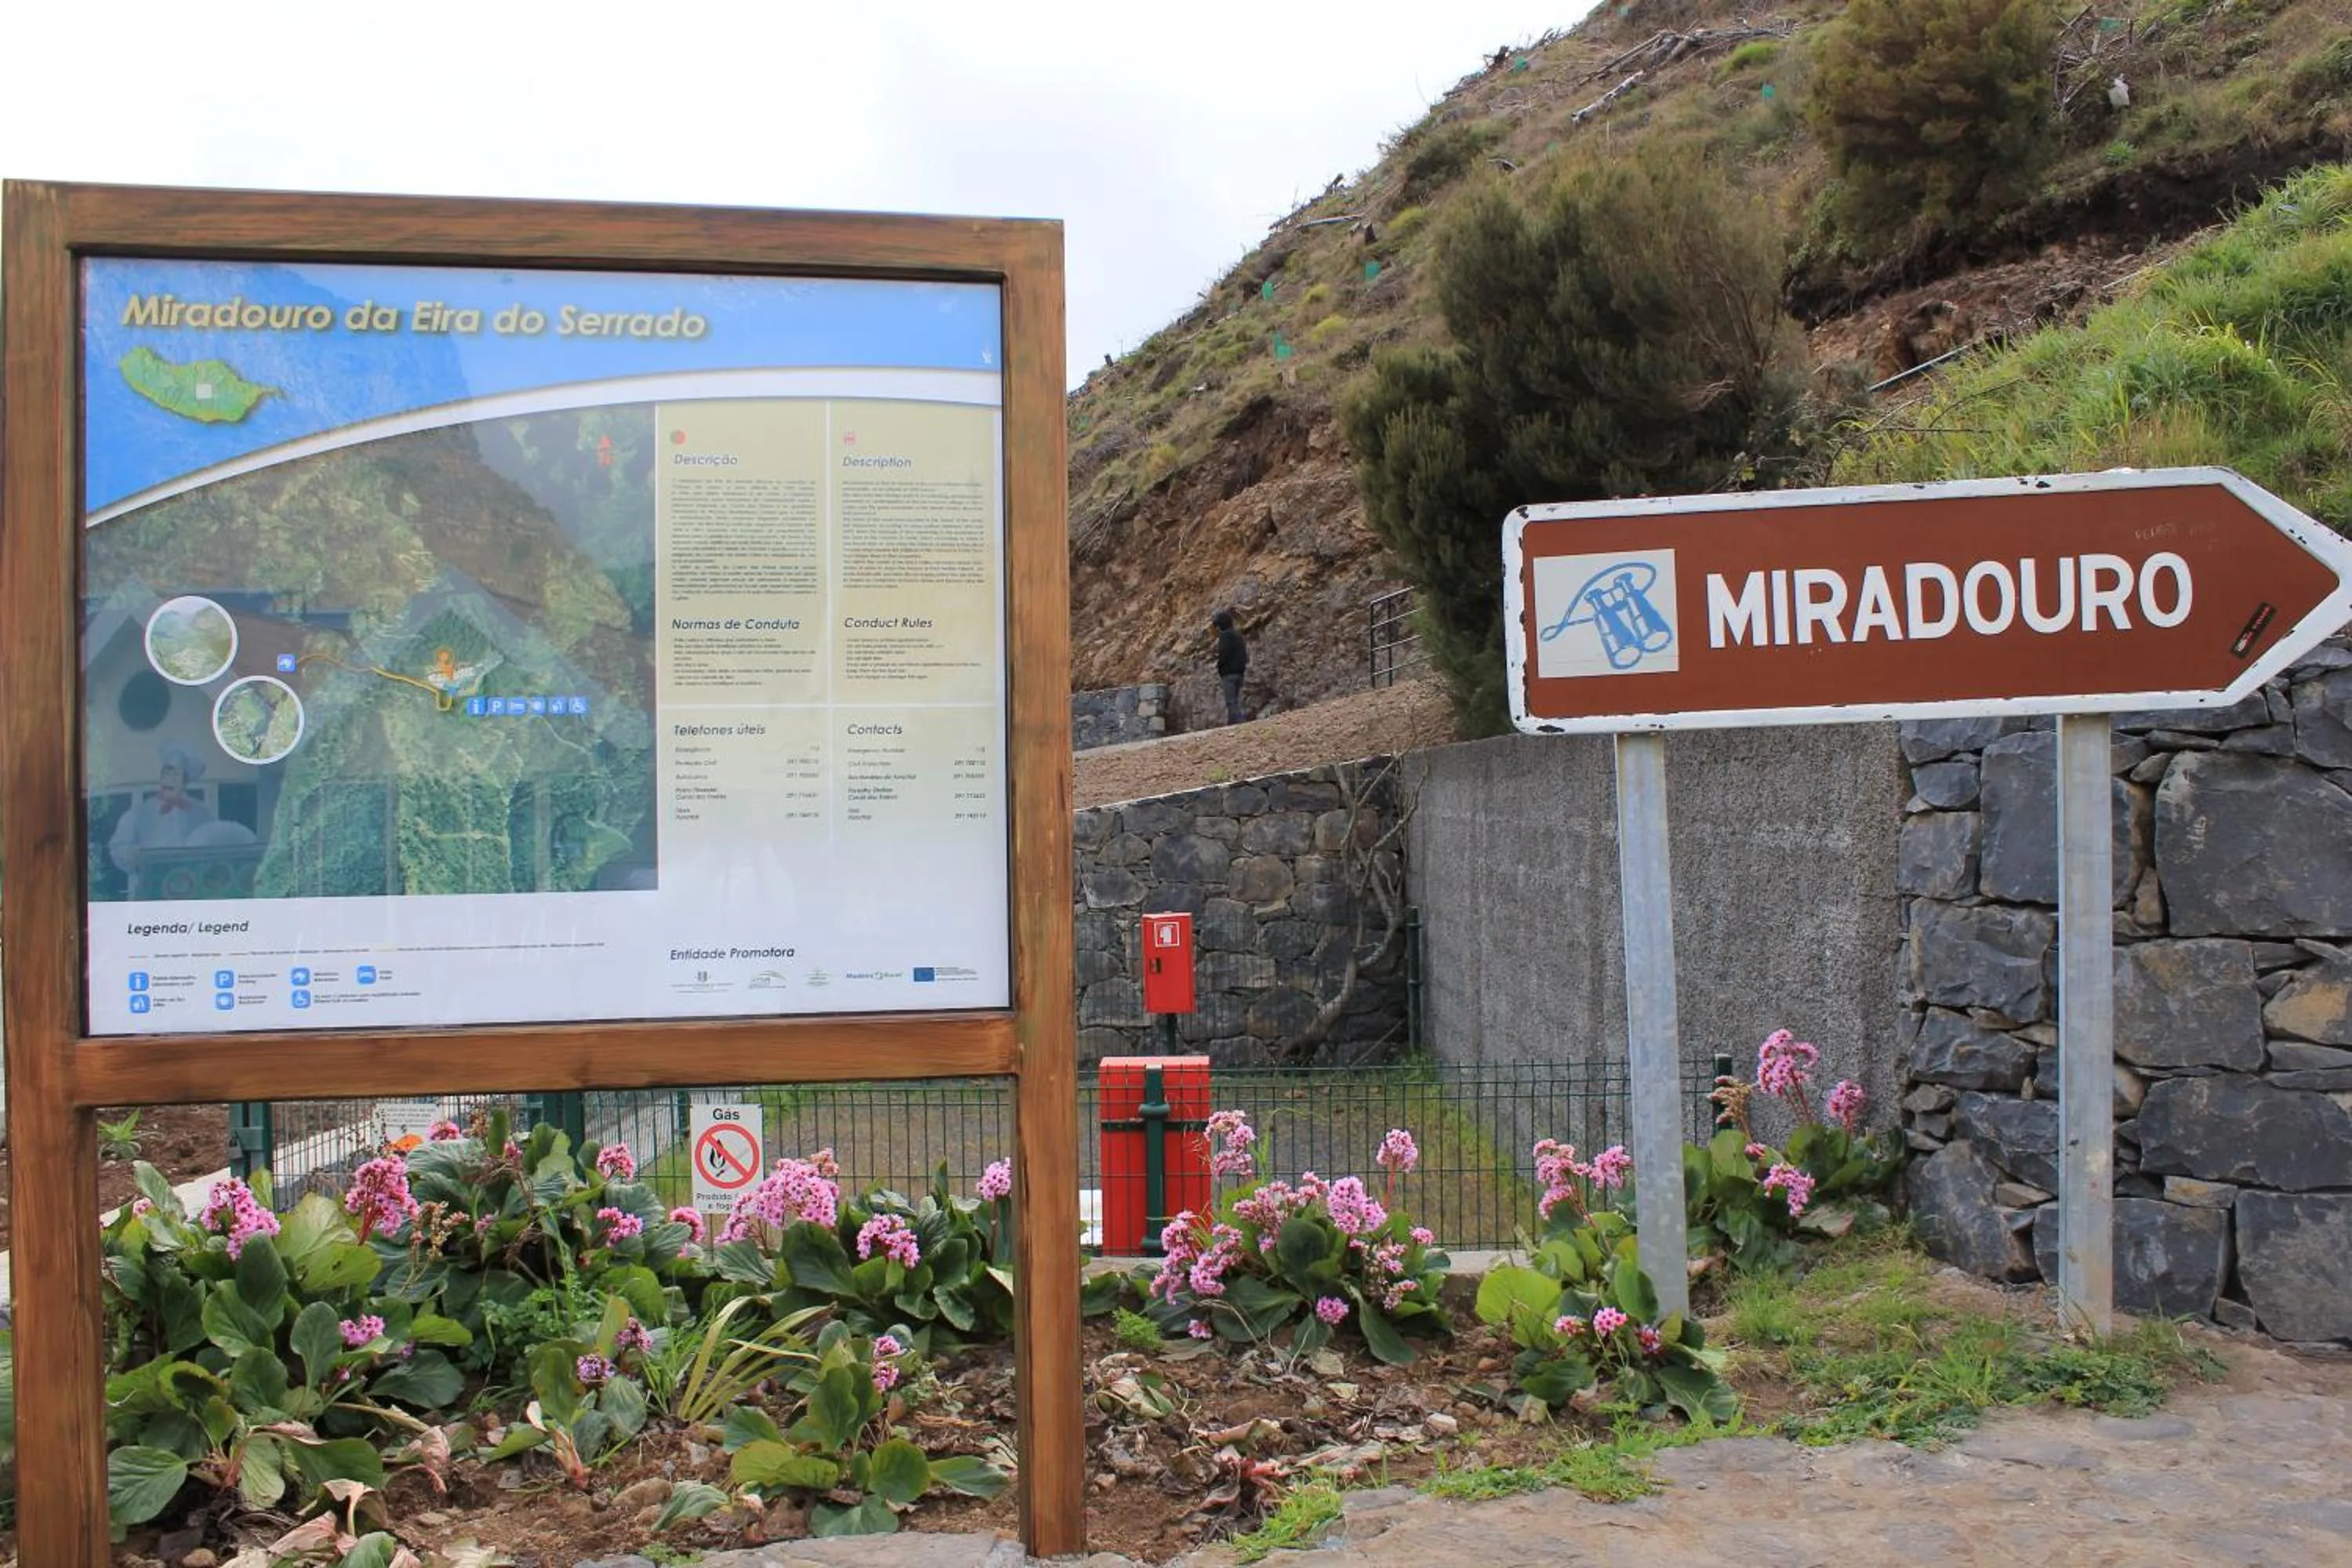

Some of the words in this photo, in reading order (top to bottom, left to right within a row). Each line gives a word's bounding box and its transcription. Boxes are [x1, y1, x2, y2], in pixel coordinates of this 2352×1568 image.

[120, 295, 332, 329] Miradouro
[344, 299, 398, 332] da
[411, 301, 480, 335] Eira
[493, 303, 546, 336] do
[557, 304, 707, 340] Serrado
[674, 454, 739, 466] Descrição
[842, 456, 912, 469] Description
[1706, 551, 2194, 650] MIRADOURO
[671, 619, 720, 630] Normas
[724, 619, 742, 630] de
[744, 619, 800, 630] Conduta
[844, 617, 899, 628] Conduct
[901, 617, 933, 628] Rules
[674, 724, 733, 735] Telefones
[736, 723, 766, 735] úteis
[847, 724, 903, 735] Contacts
[198, 920, 250, 936] Legend
[670, 947, 727, 960] Entidade
[729, 946, 796, 959] Promotora
[712, 1108, 741, 1121] Gás
